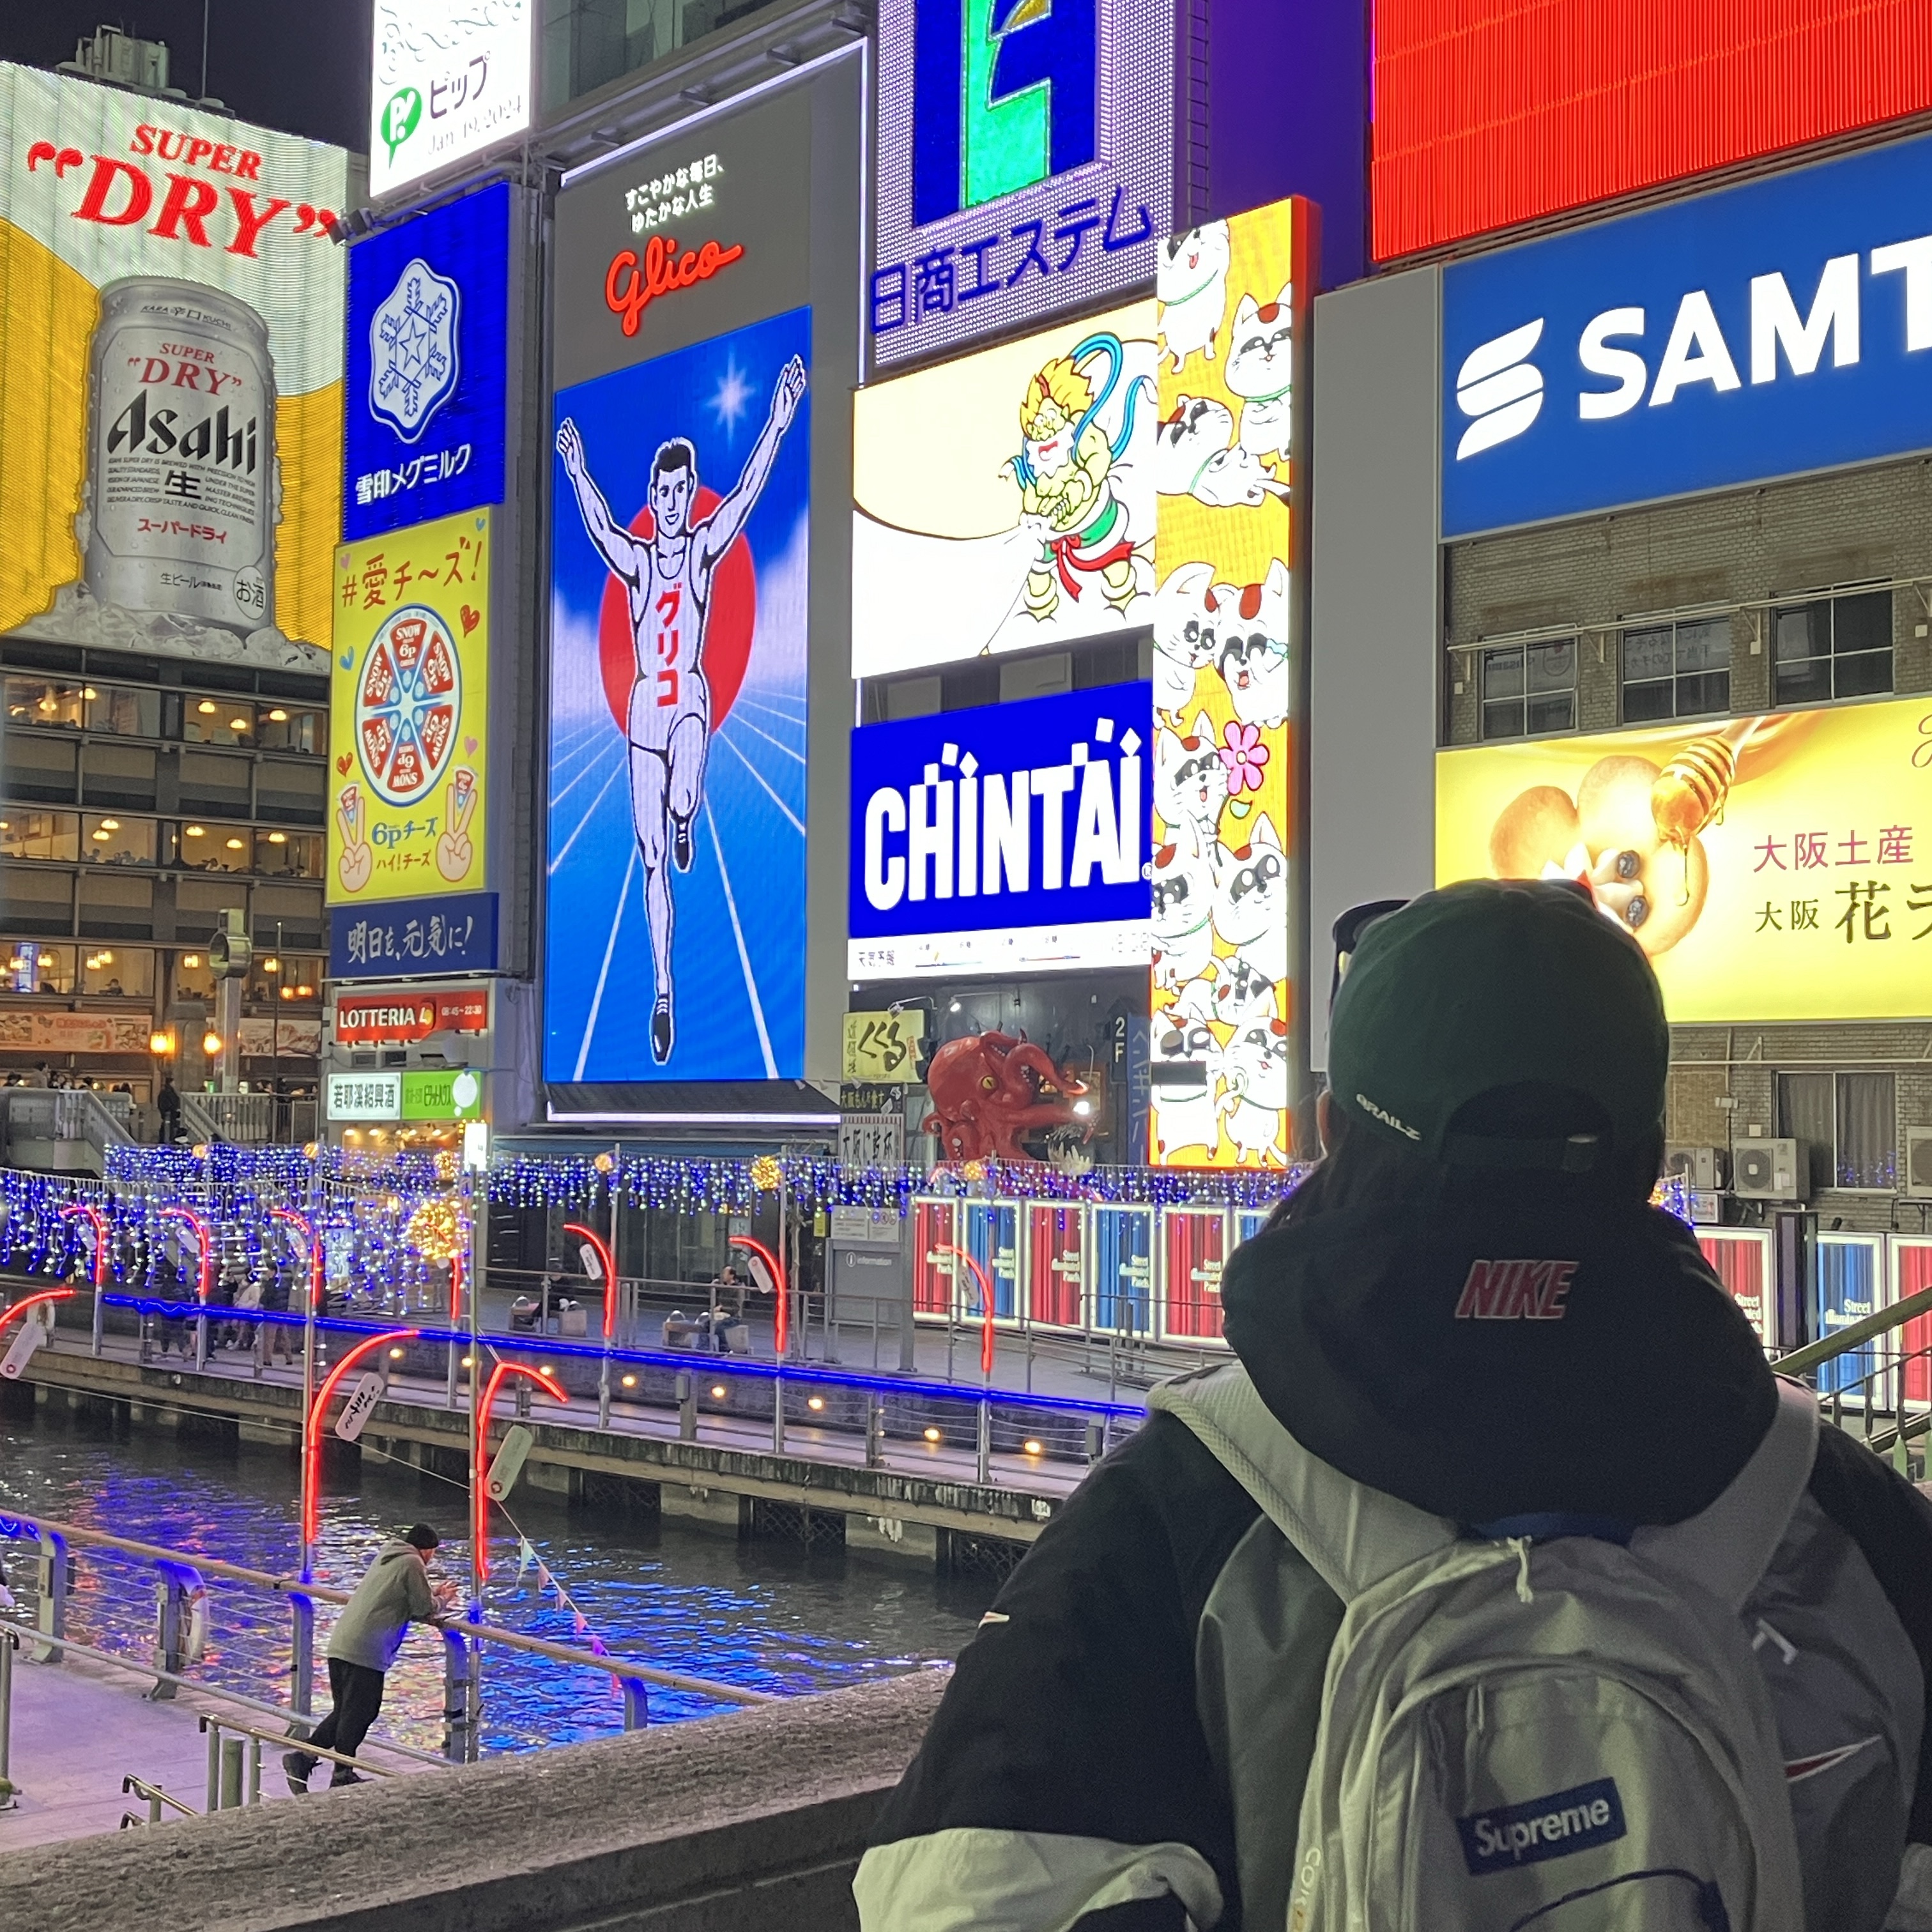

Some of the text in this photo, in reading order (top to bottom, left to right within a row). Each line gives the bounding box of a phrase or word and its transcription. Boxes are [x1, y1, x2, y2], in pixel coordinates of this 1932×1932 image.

[431, 50, 491, 119] ピップ
[130, 124, 262, 180] SUPER
[625, 153, 724, 211] すこやかな毎日、
[631, 183, 714, 233] ゆたかな人生
[870, 186, 1152, 334] 日商エステム
[606, 236, 743, 336] Glico
[159, 342, 215, 364] SUPER
[107, 388, 256, 475] Asahi
[164, 469, 202, 500] 生
[355, 443, 471, 505] 雪印メグミルク
[137, 518, 227, 544] スーパードライ
[160, 572, 201, 588] 生ビール
[236, 579, 264, 609] お酒
[395, 624, 422, 640] SNOW
[655, 581, 682, 707] グリコ
[433, 642, 451, 682] SNOW
[392, 772, 418, 788] SNOW
[864, 728, 1142, 910] CHINTAI
[1752, 824, 1914, 873] 大阪土産
[1754, 898, 1820, 933] 大阪
[339, 1008, 415, 1028] LOTTERIA
[857, 1021, 907, 1071] くくる
[1455, 1259, 1580, 1319] NIKE
[1844, 1298, 1871, 1314] Street
[1475, 1798, 1609, 1860] Supreme
